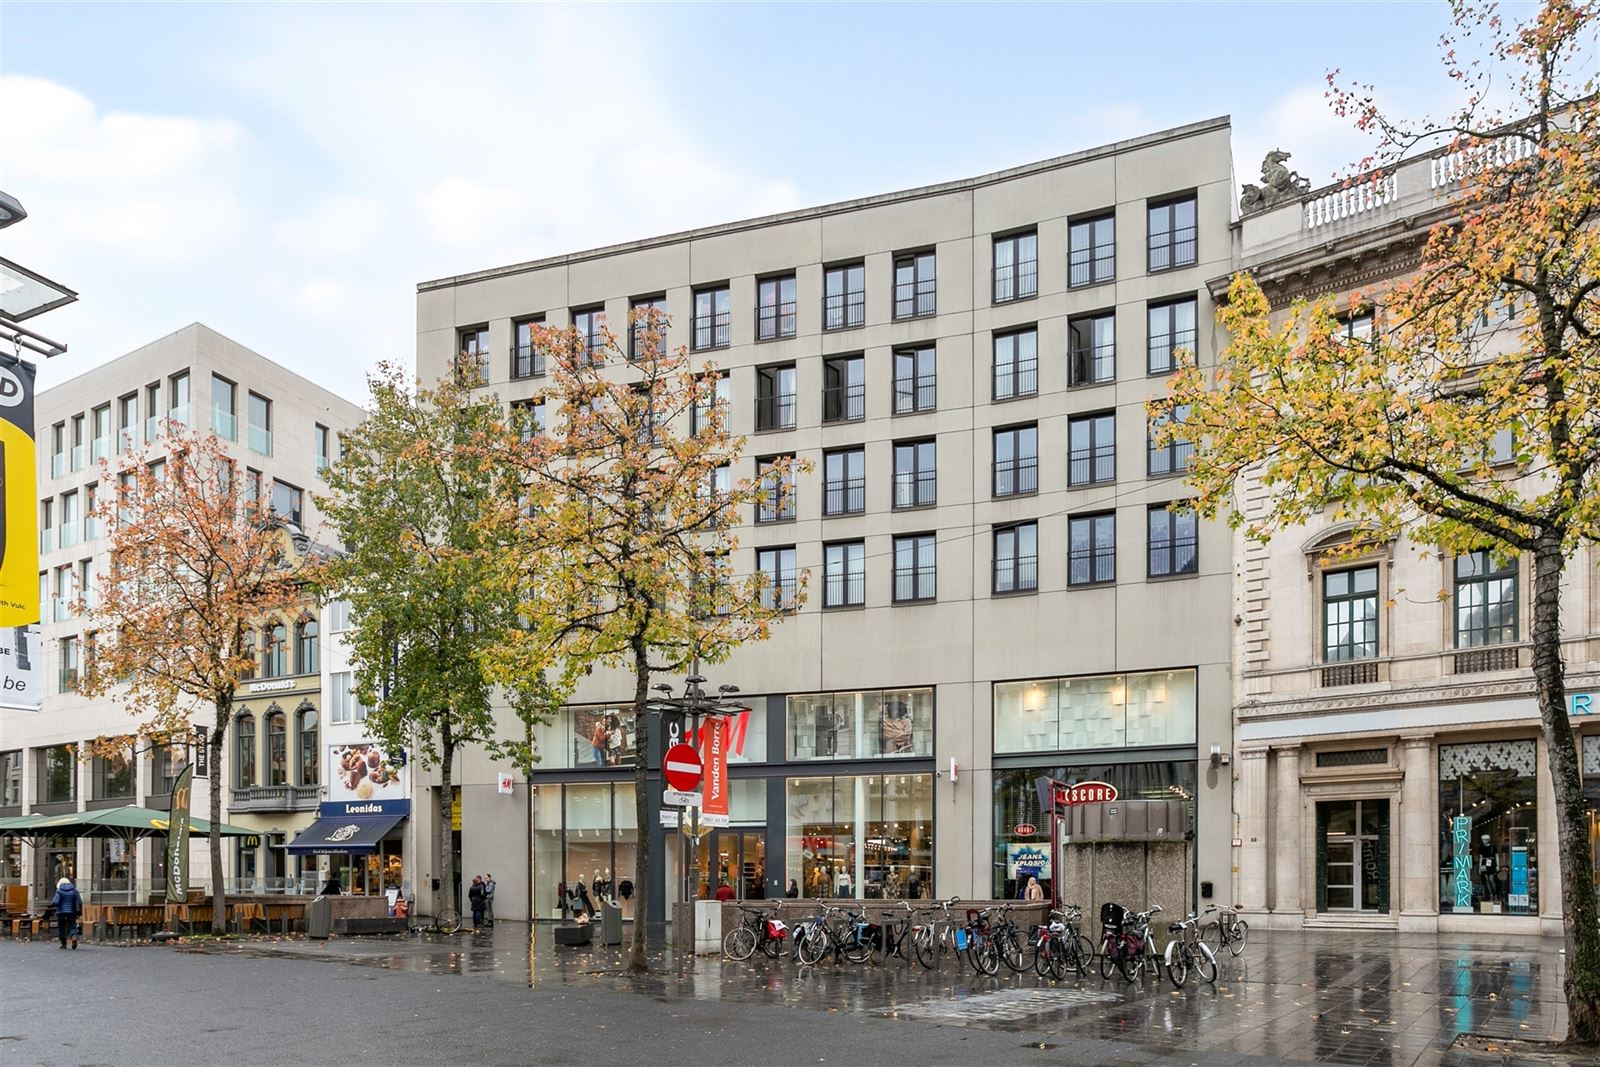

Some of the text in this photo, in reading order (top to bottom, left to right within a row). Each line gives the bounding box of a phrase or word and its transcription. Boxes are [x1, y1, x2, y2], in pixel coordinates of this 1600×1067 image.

[249, 680, 297, 693] McDonald's
[711, 723, 720, 754] Borre
[711, 758, 720, 800] Vanden
[1072, 788, 1111, 802] SCORE
[345, 803, 383, 813] Leonidas
[1455, 817, 1471, 906] PRIMARK
